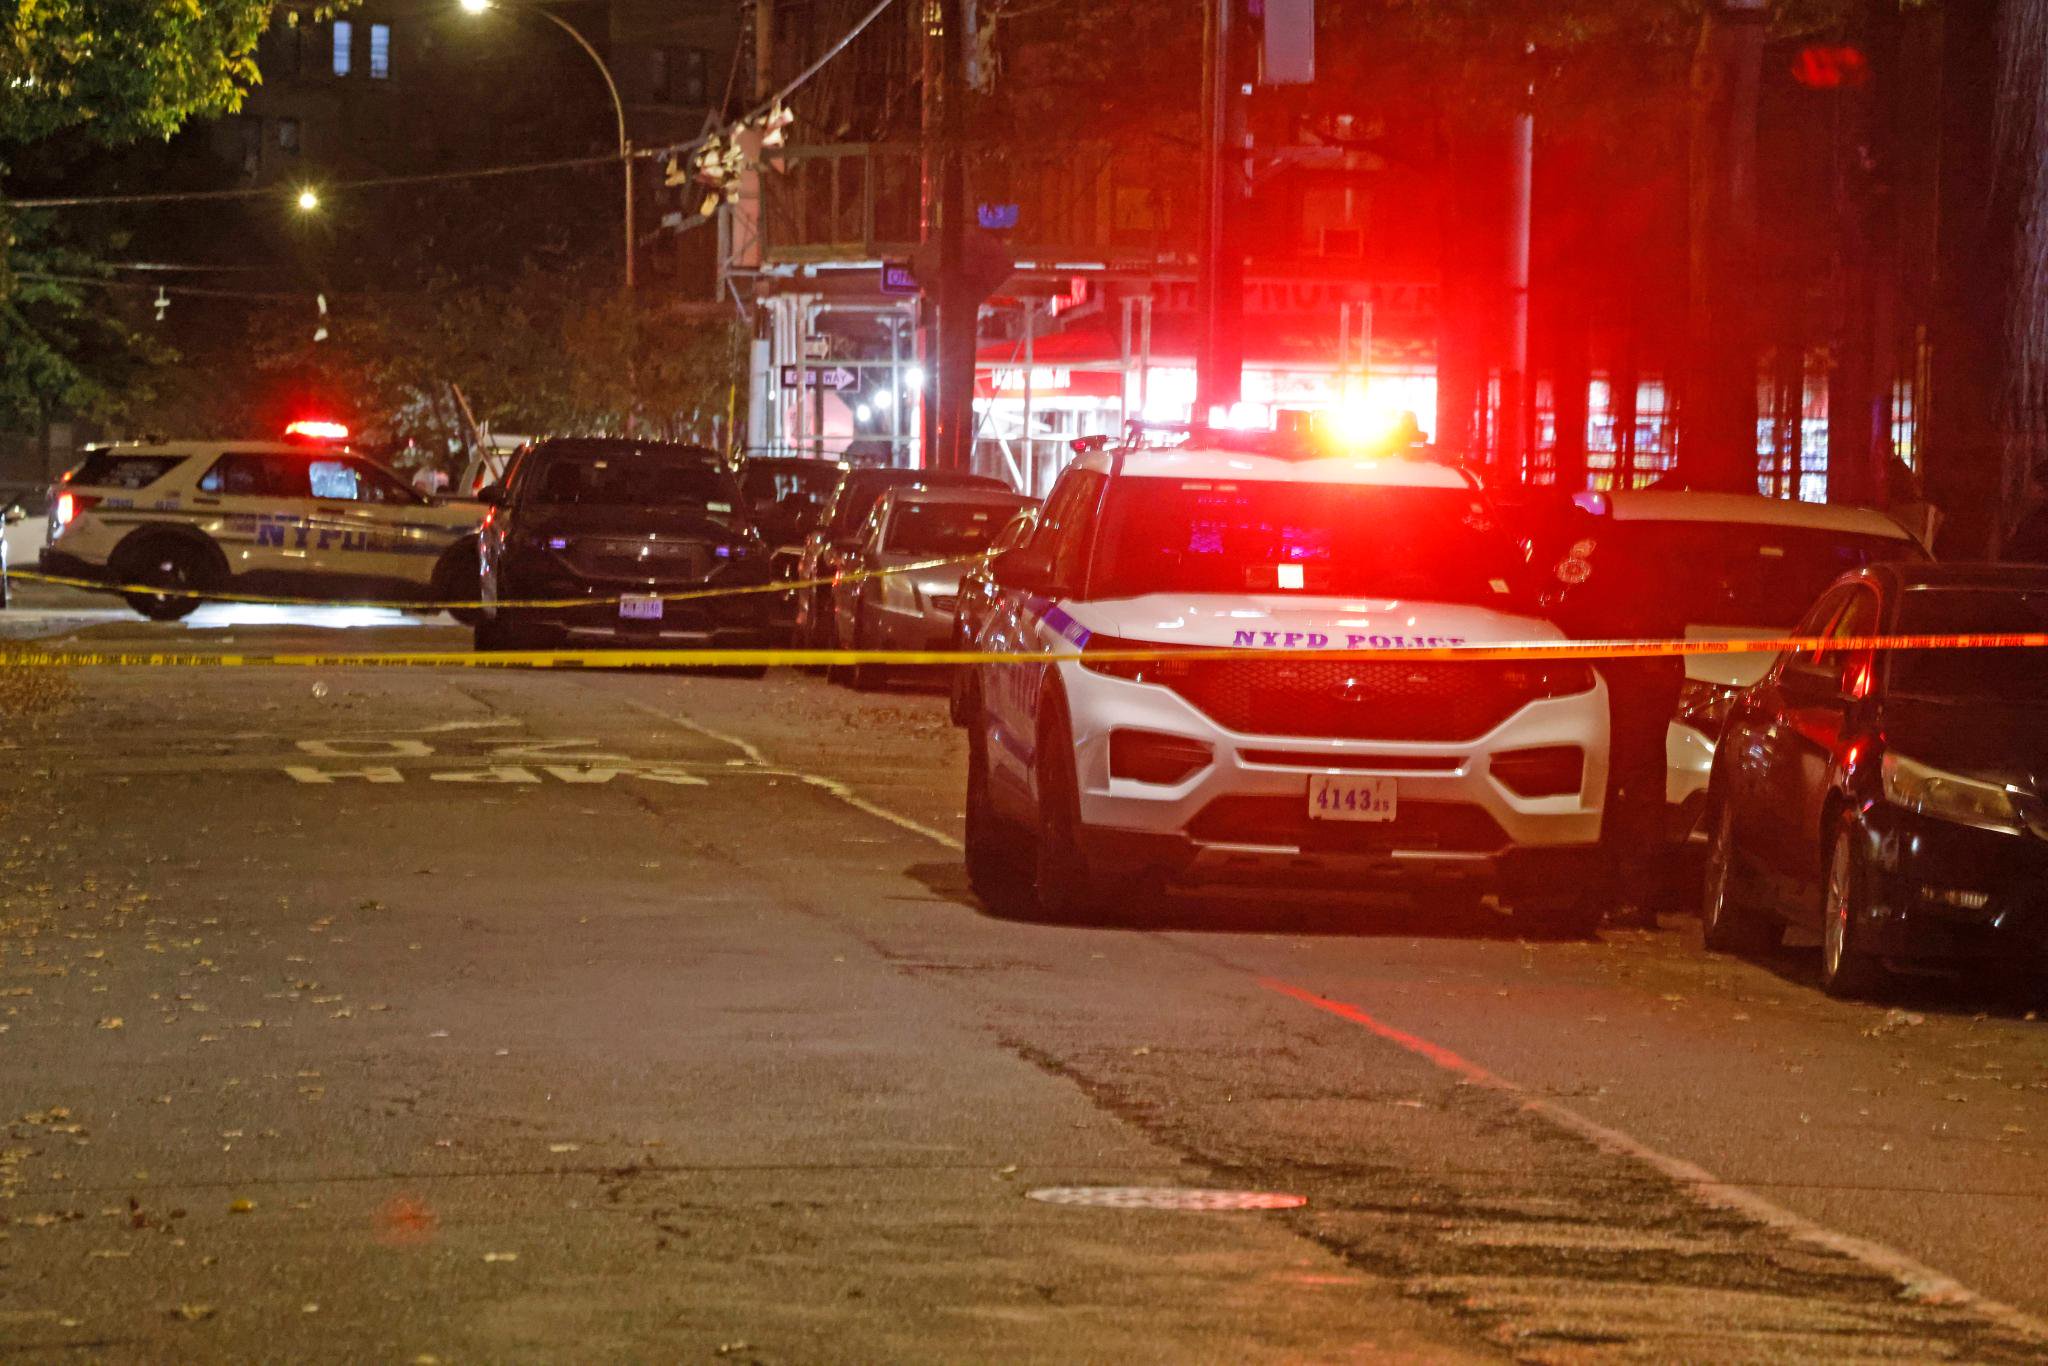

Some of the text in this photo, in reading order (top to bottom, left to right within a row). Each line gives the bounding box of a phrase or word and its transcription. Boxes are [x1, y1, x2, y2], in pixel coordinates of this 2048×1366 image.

[823, 371, 848, 382] WAY
[1233, 631, 1329, 649] NYPD
[1317, 789, 1371, 811] 4143
